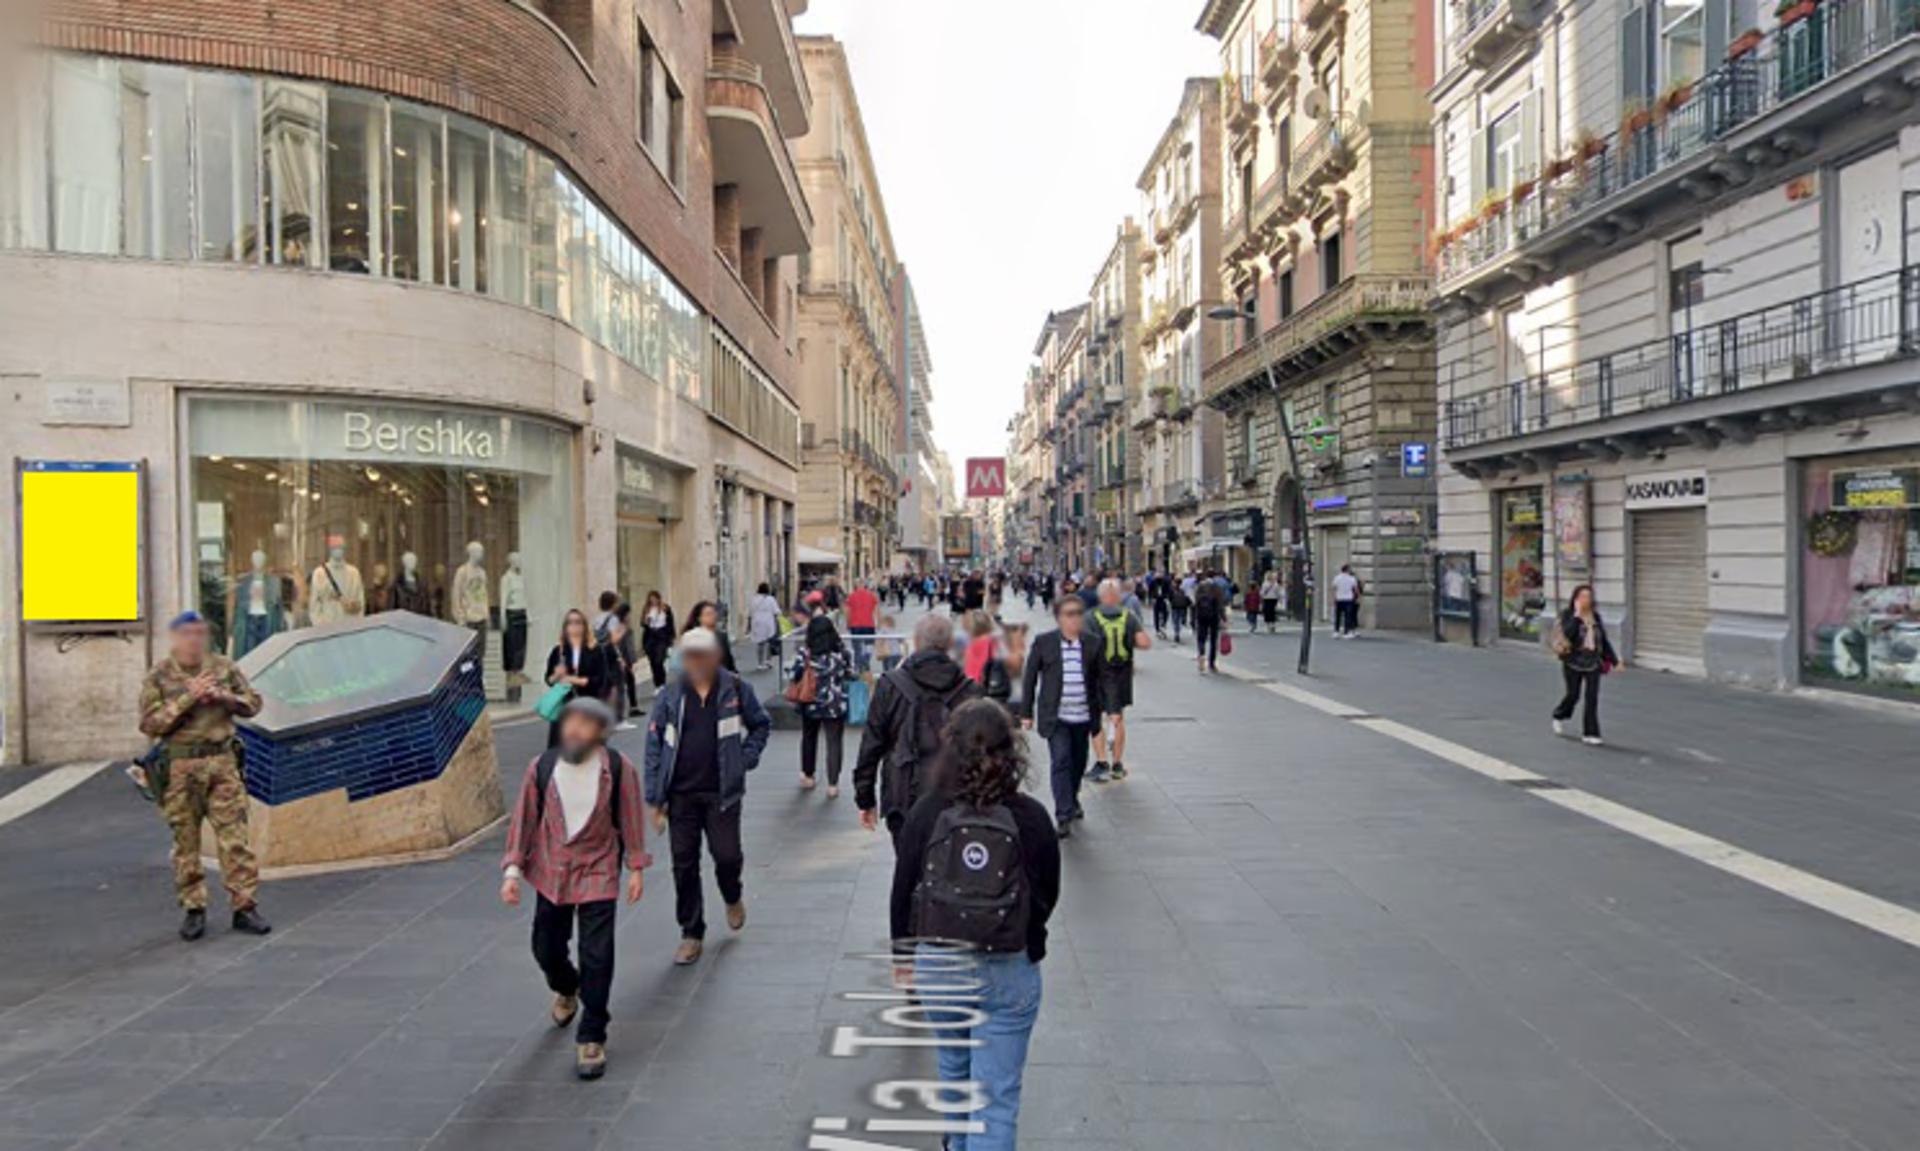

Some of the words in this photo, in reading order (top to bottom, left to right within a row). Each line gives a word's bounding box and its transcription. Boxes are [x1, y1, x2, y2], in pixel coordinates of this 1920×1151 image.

[344, 411, 494, 458] Bershka
[970, 466, 1002, 489] M
[1627, 478, 1692, 500] KASANOVA
